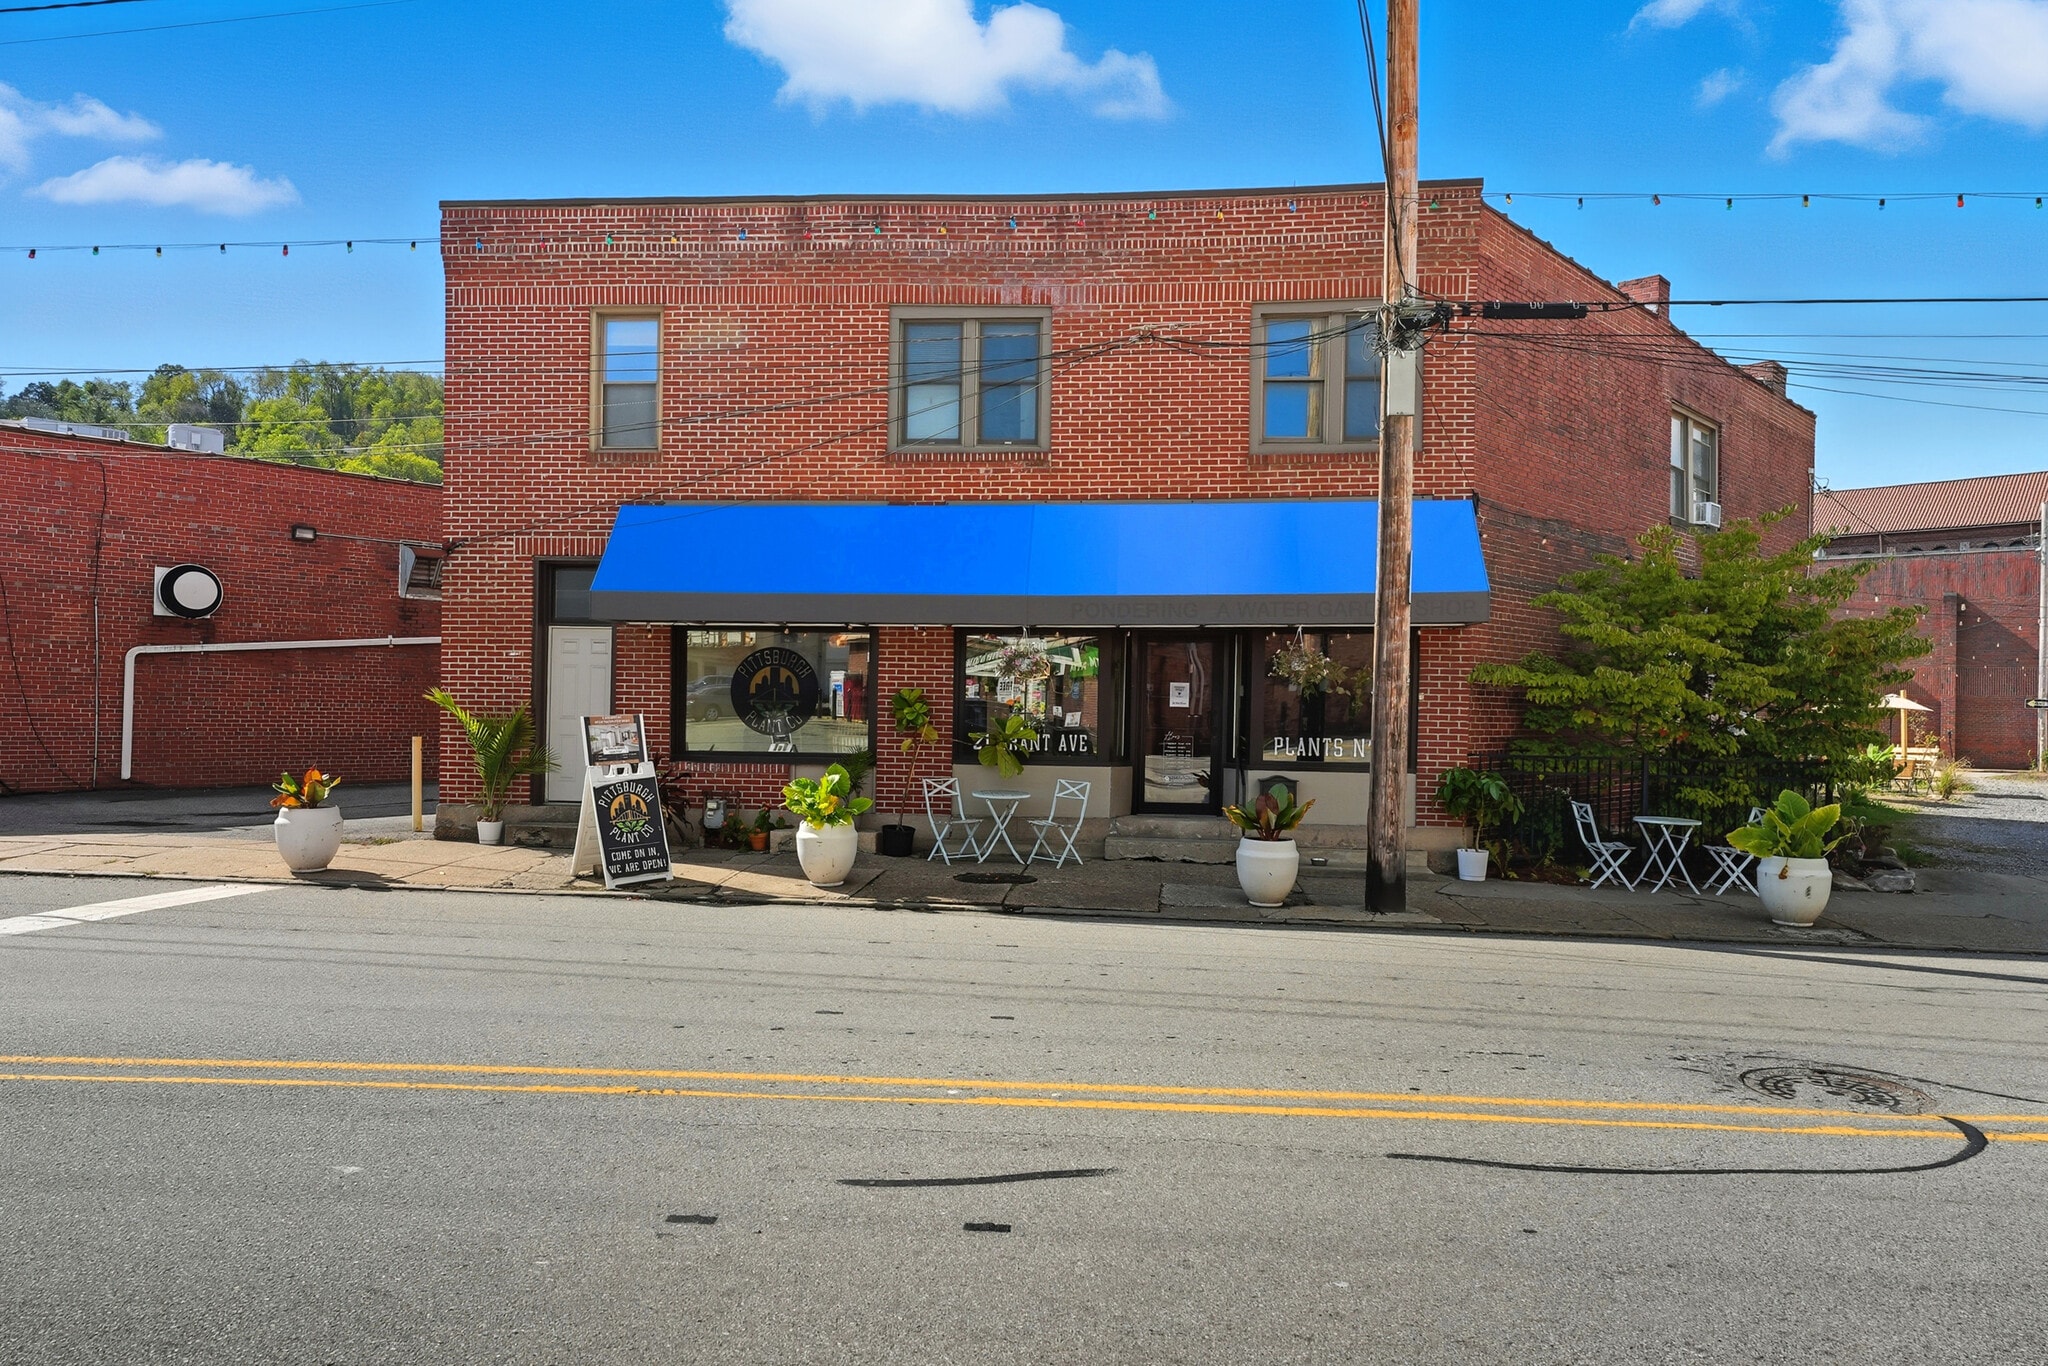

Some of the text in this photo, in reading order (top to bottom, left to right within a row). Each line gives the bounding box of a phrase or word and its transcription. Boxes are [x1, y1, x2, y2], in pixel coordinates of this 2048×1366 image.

[1070, 601, 1199, 619] PONDERING
[1216, 601, 1231, 618] A
[1237, 601, 1310, 618] WATER
[738, 649, 813, 679] PITTSBURGH
[745, 710, 782, 733] PLANT
[1002, 733, 1051, 751] RANT
[1058, 733, 1088, 752] AVE
[1273, 736, 1344, 757] PLANTS
[598, 781, 655, 808] PITTSBURGH
[609, 823, 655, 844] PLANT CO
[611, 846, 660, 862] COME ON IN,
[608, 858, 667, 874] WE ARE OPEN!
